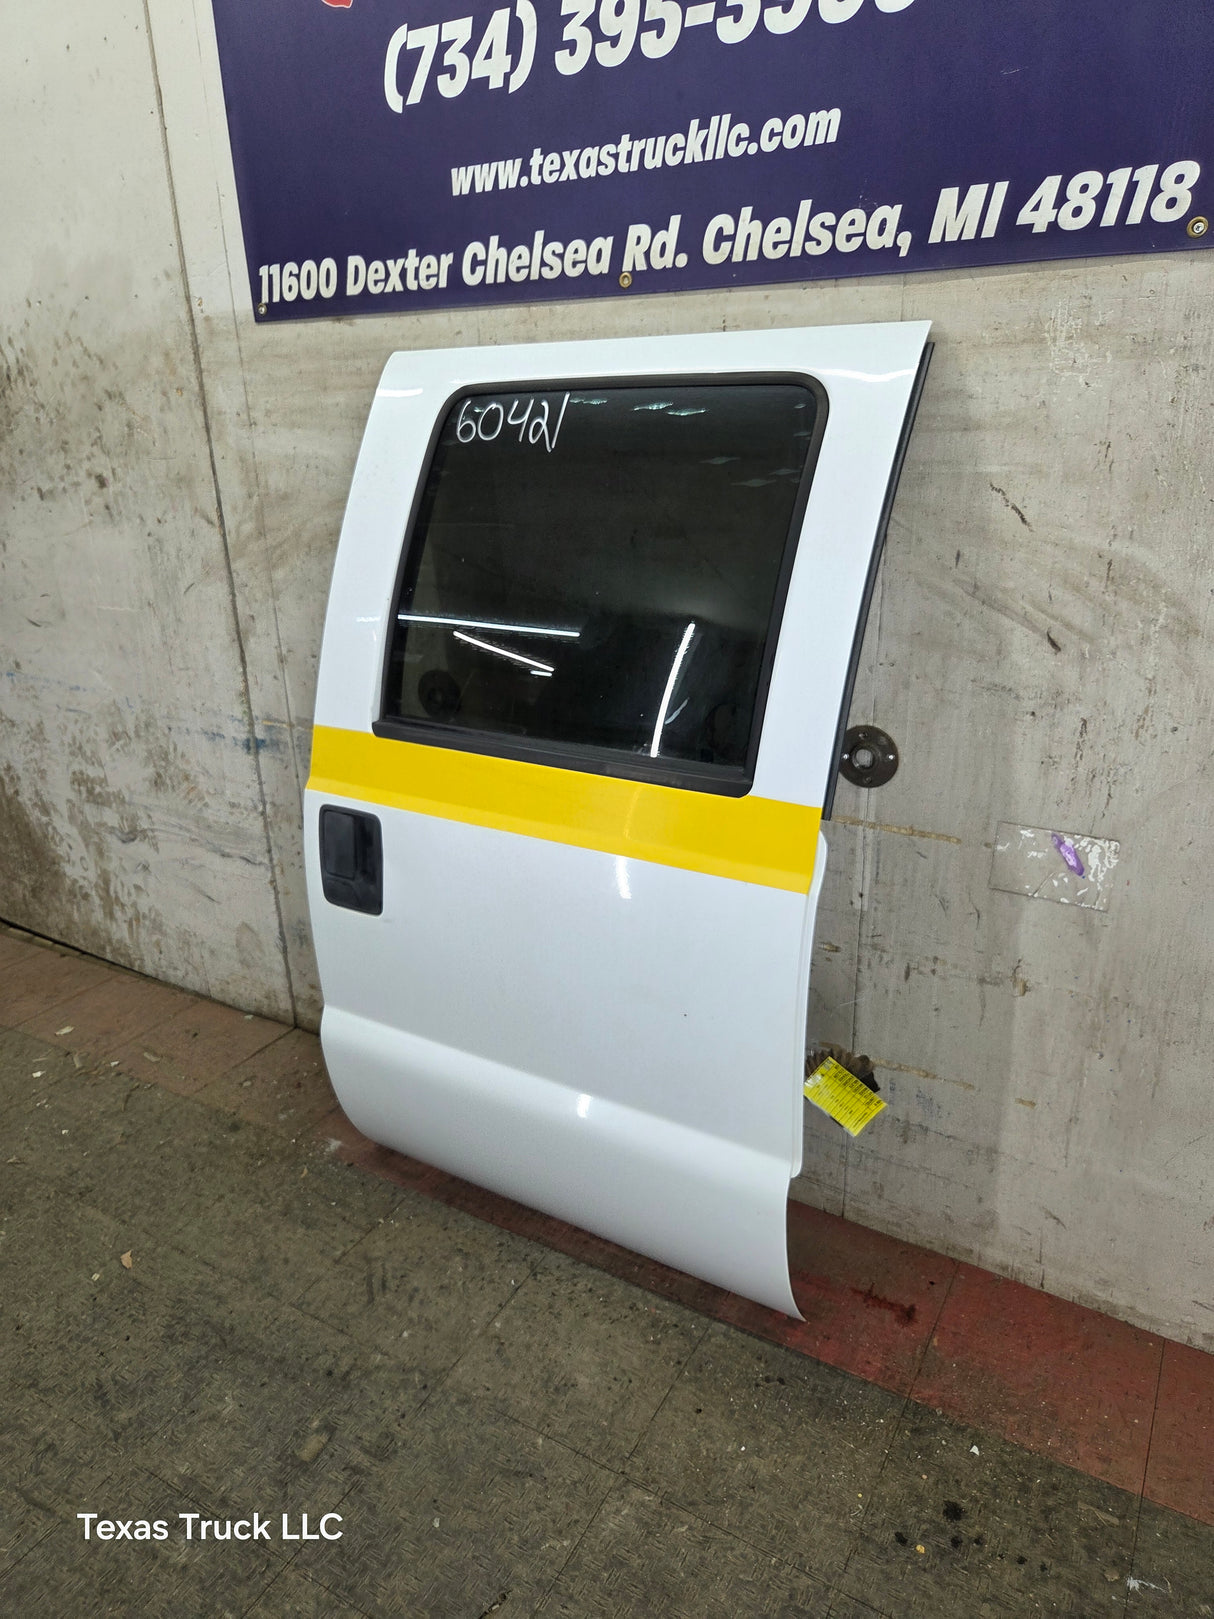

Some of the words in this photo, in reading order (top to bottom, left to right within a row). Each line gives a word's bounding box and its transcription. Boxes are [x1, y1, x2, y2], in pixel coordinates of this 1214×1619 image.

[384, 7, 538, 114] (734)
[554, 0, 915, 76] 395-
[450, 107, 842, 197] www.texastruckllc.com
[258, 257, 338, 304] 11600
[346, 249, 454, 297] Dexter
[461, 230, 614, 287] Chelsea
[622, 214, 689, 272] Rd.
[702, 198, 912, 265] Chelsea,
[928, 180, 1010, 244] MI
[1015, 159, 1201, 234] 48118
